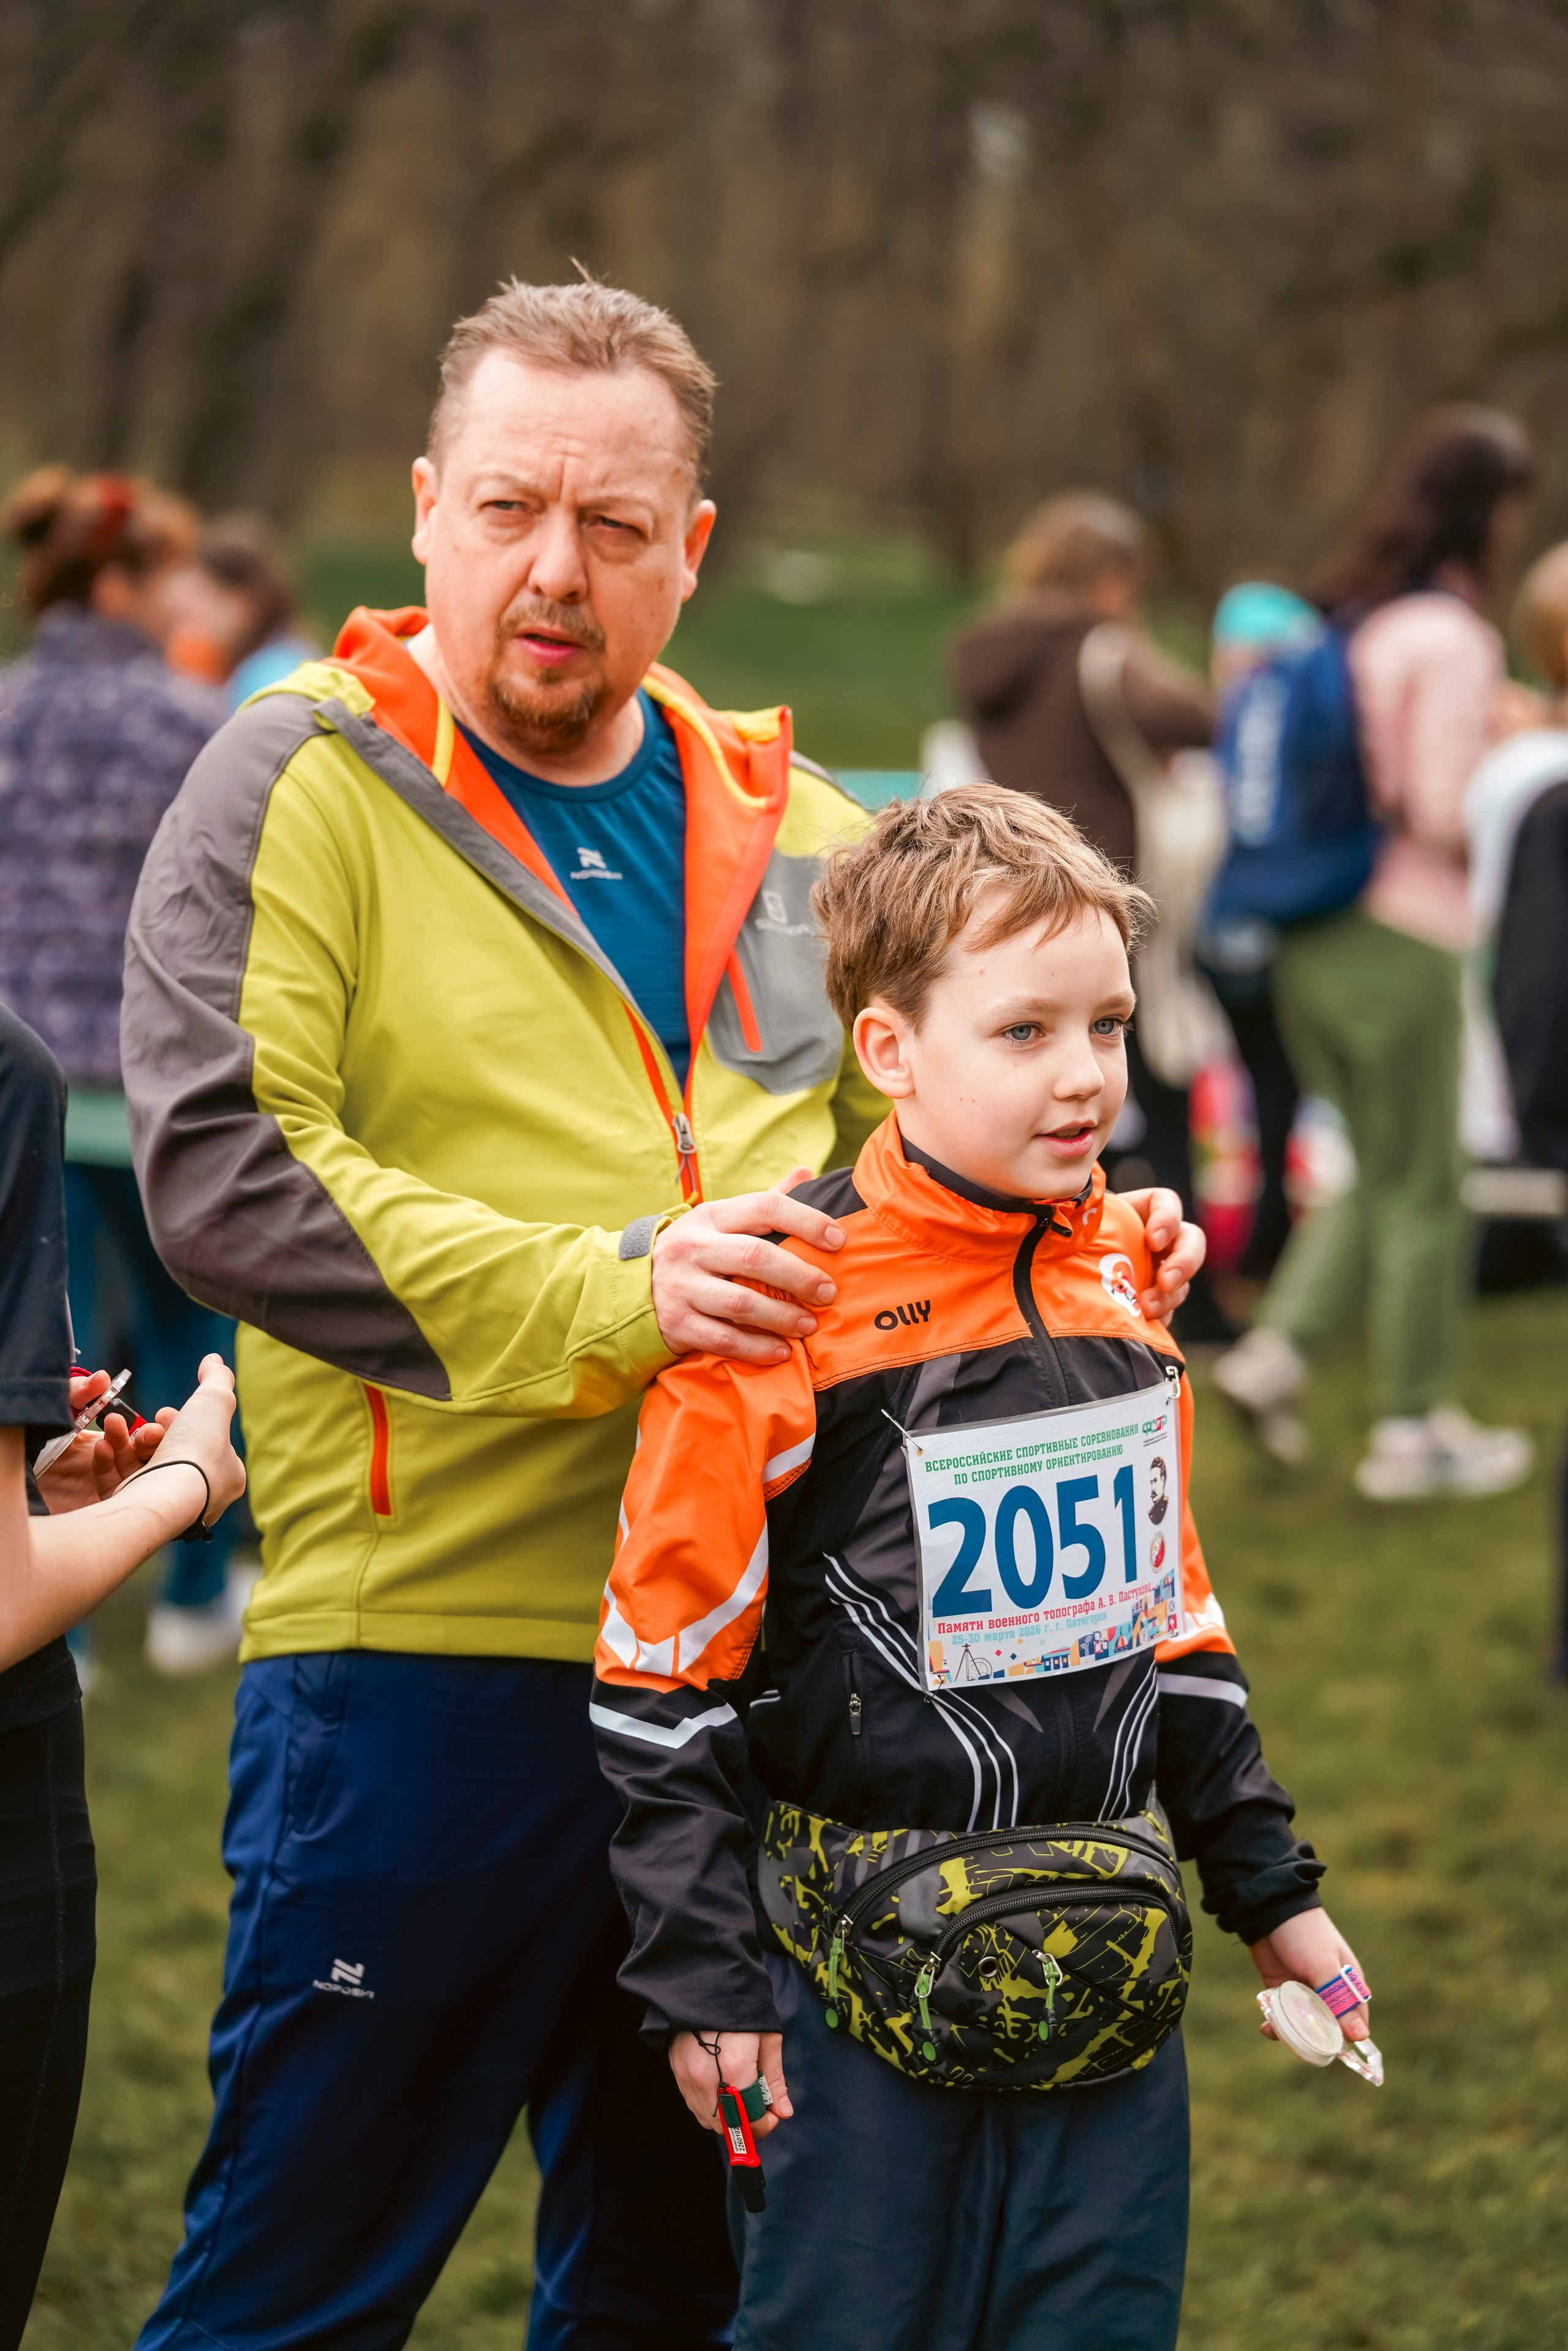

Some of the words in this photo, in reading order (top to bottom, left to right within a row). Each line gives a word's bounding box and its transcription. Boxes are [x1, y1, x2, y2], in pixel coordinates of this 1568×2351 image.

[874, 1300, 930, 1330] OLLY
[925, 1449, 1012, 1473] ВСЕРОССИЙСКИЕ
[1016, 1438, 1078, 1459] СПОРТИВНЫЕ
[1080, 1424, 1139, 1447] СОРЕВНОВАНИЯ
[954, 1473, 968, 1485] ПО
[971, 1460, 1042, 1482] СПОРТИВНОМУ
[1046, 1444, 1123, 1470] ОРИЕНТИРОВАНИЮ
[928, 1464, 1137, 1618] 2051
[938, 1620, 984, 1634] Памяти
[988, 1612, 1039, 1629] военного
[1043, 1599, 1096, 1620] топографа
[1098, 1597, 1106, 1609] А.
[1109, 1594, 1117, 1606] В.
[1118, 1582, 1152, 1603] Пастухова
[952, 1632, 981, 1645] 25-30
[984, 1630, 1016, 1643] марта
[1019, 1624, 1041, 1637] 2026
[1044, 1625, 1053, 1634] г.
[1055, 1622, 1063, 1631] г.
[1066, 1612, 1107, 1629] Пятигорск
[730, 2127, 739, 2152] SPORTiden
[734, 2126, 745, 2151] 2260102
